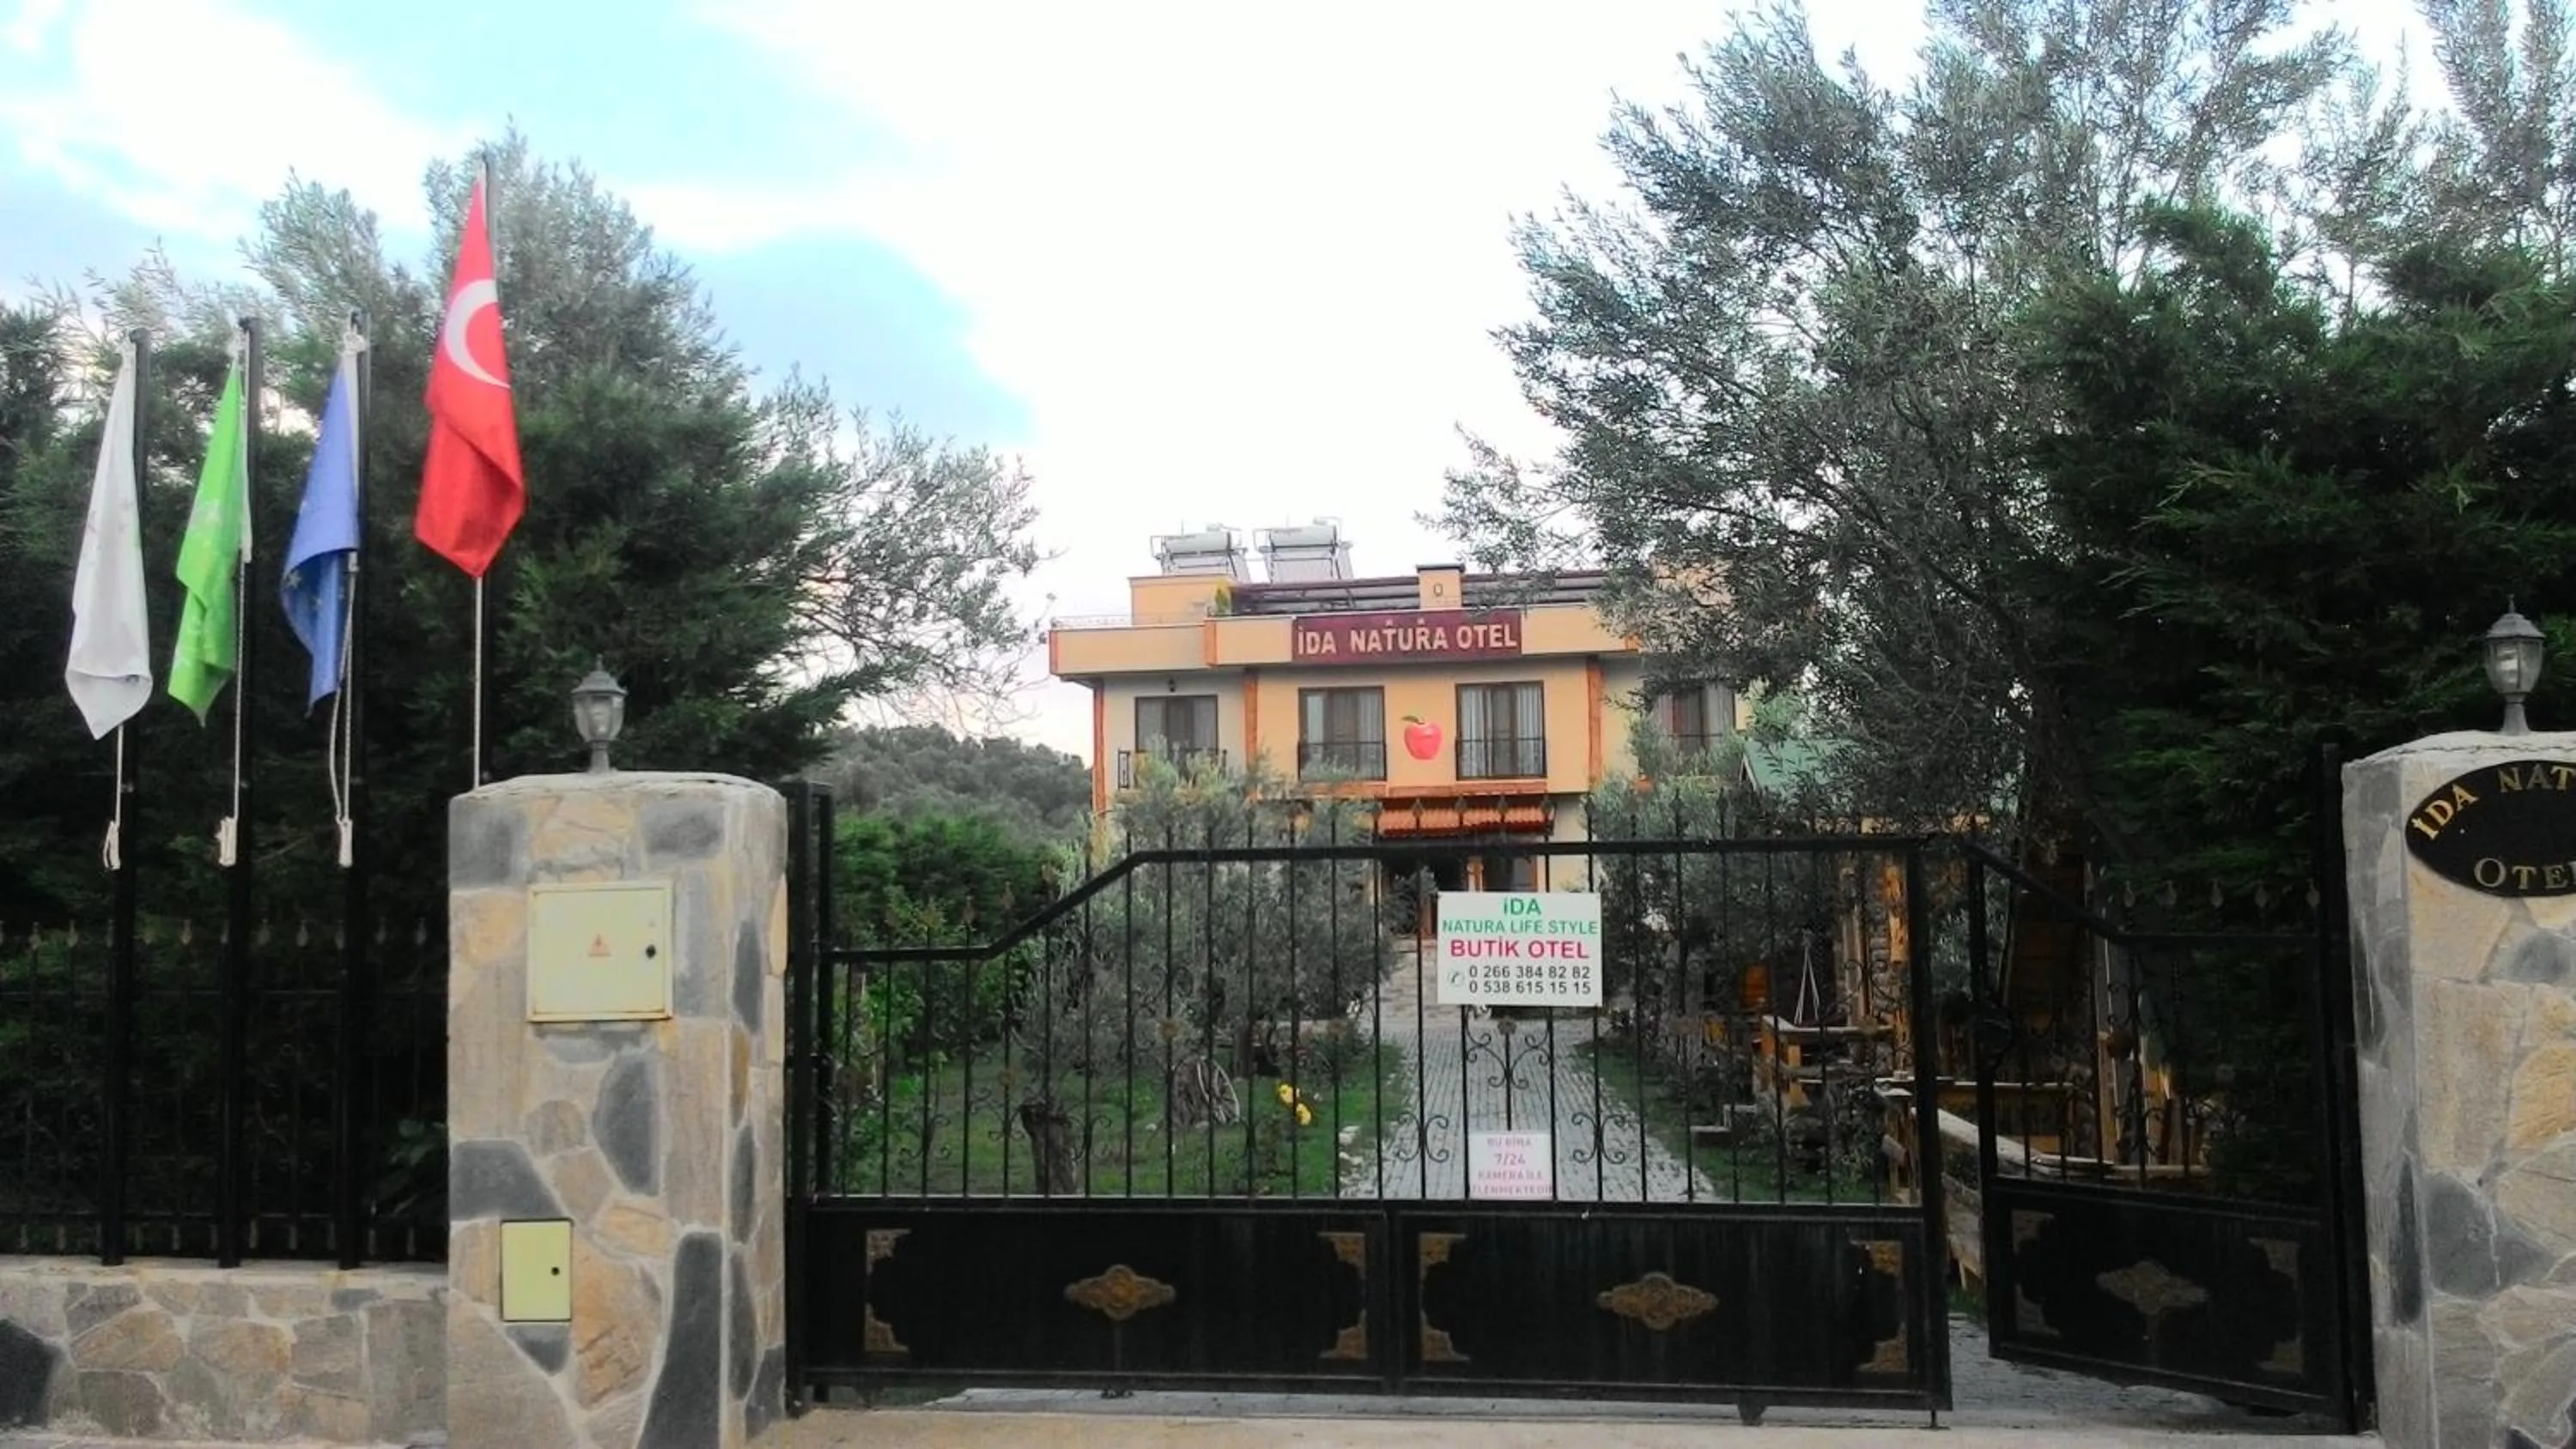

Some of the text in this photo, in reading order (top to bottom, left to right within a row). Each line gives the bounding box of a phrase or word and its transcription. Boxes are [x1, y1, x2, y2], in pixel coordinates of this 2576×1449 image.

[1455, 624, 1517, 648] OTEL
[1443, 919, 1598, 934] NATURA LIFE STYLE
[1450, 936, 1589, 958] BUTİK OTEL
[1469, 966, 1591, 979] 0 266 384 82 82
[1469, 981, 1591, 994] 0 538 615 15 15
[1495, 1153, 1526, 1165] 7/24
